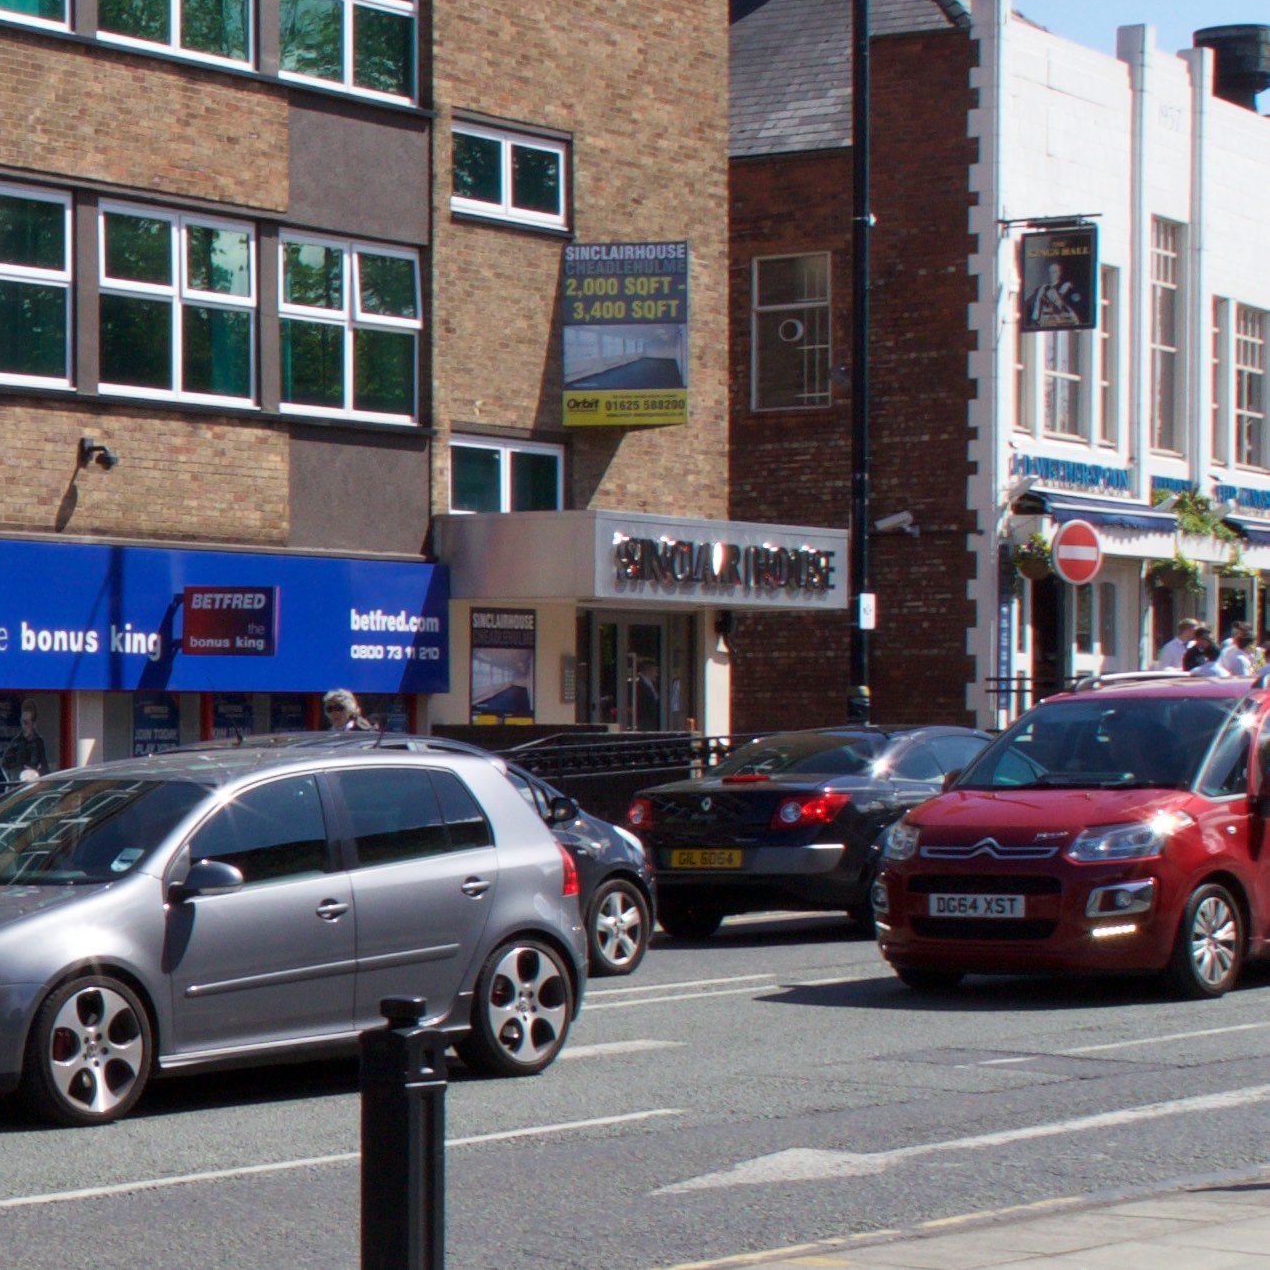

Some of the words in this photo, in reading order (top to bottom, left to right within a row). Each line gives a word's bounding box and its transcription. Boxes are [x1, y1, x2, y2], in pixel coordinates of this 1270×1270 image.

[566, 244, 685, 260] SINCLAIRHOUSE
[566, 277, 619, 298] 2,000
[624, 277, 672, 295] SQFT
[572, 301, 626, 322] 3,400
[631, 300, 679, 319] SQFT
[604, 400, 640, 412] 01625
[744, 542, 836, 590] HOUSE
[191, 593, 266, 609] BETFRED
[247, 622, 265, 636] the
[350, 608, 440, 633] betfred.com
[21, 621, 99, 654] bonus
[110, 625, 161, 661] king
[190, 635, 230, 648] bonus
[235, 635, 265, 650] king
[350, 644, 383, 660] 0800
[386, 645, 402, 660] 73
[418, 645, 440, 660] 210
[936, 897, 979, 914] DG64
[984, 898, 1018, 915] XST
